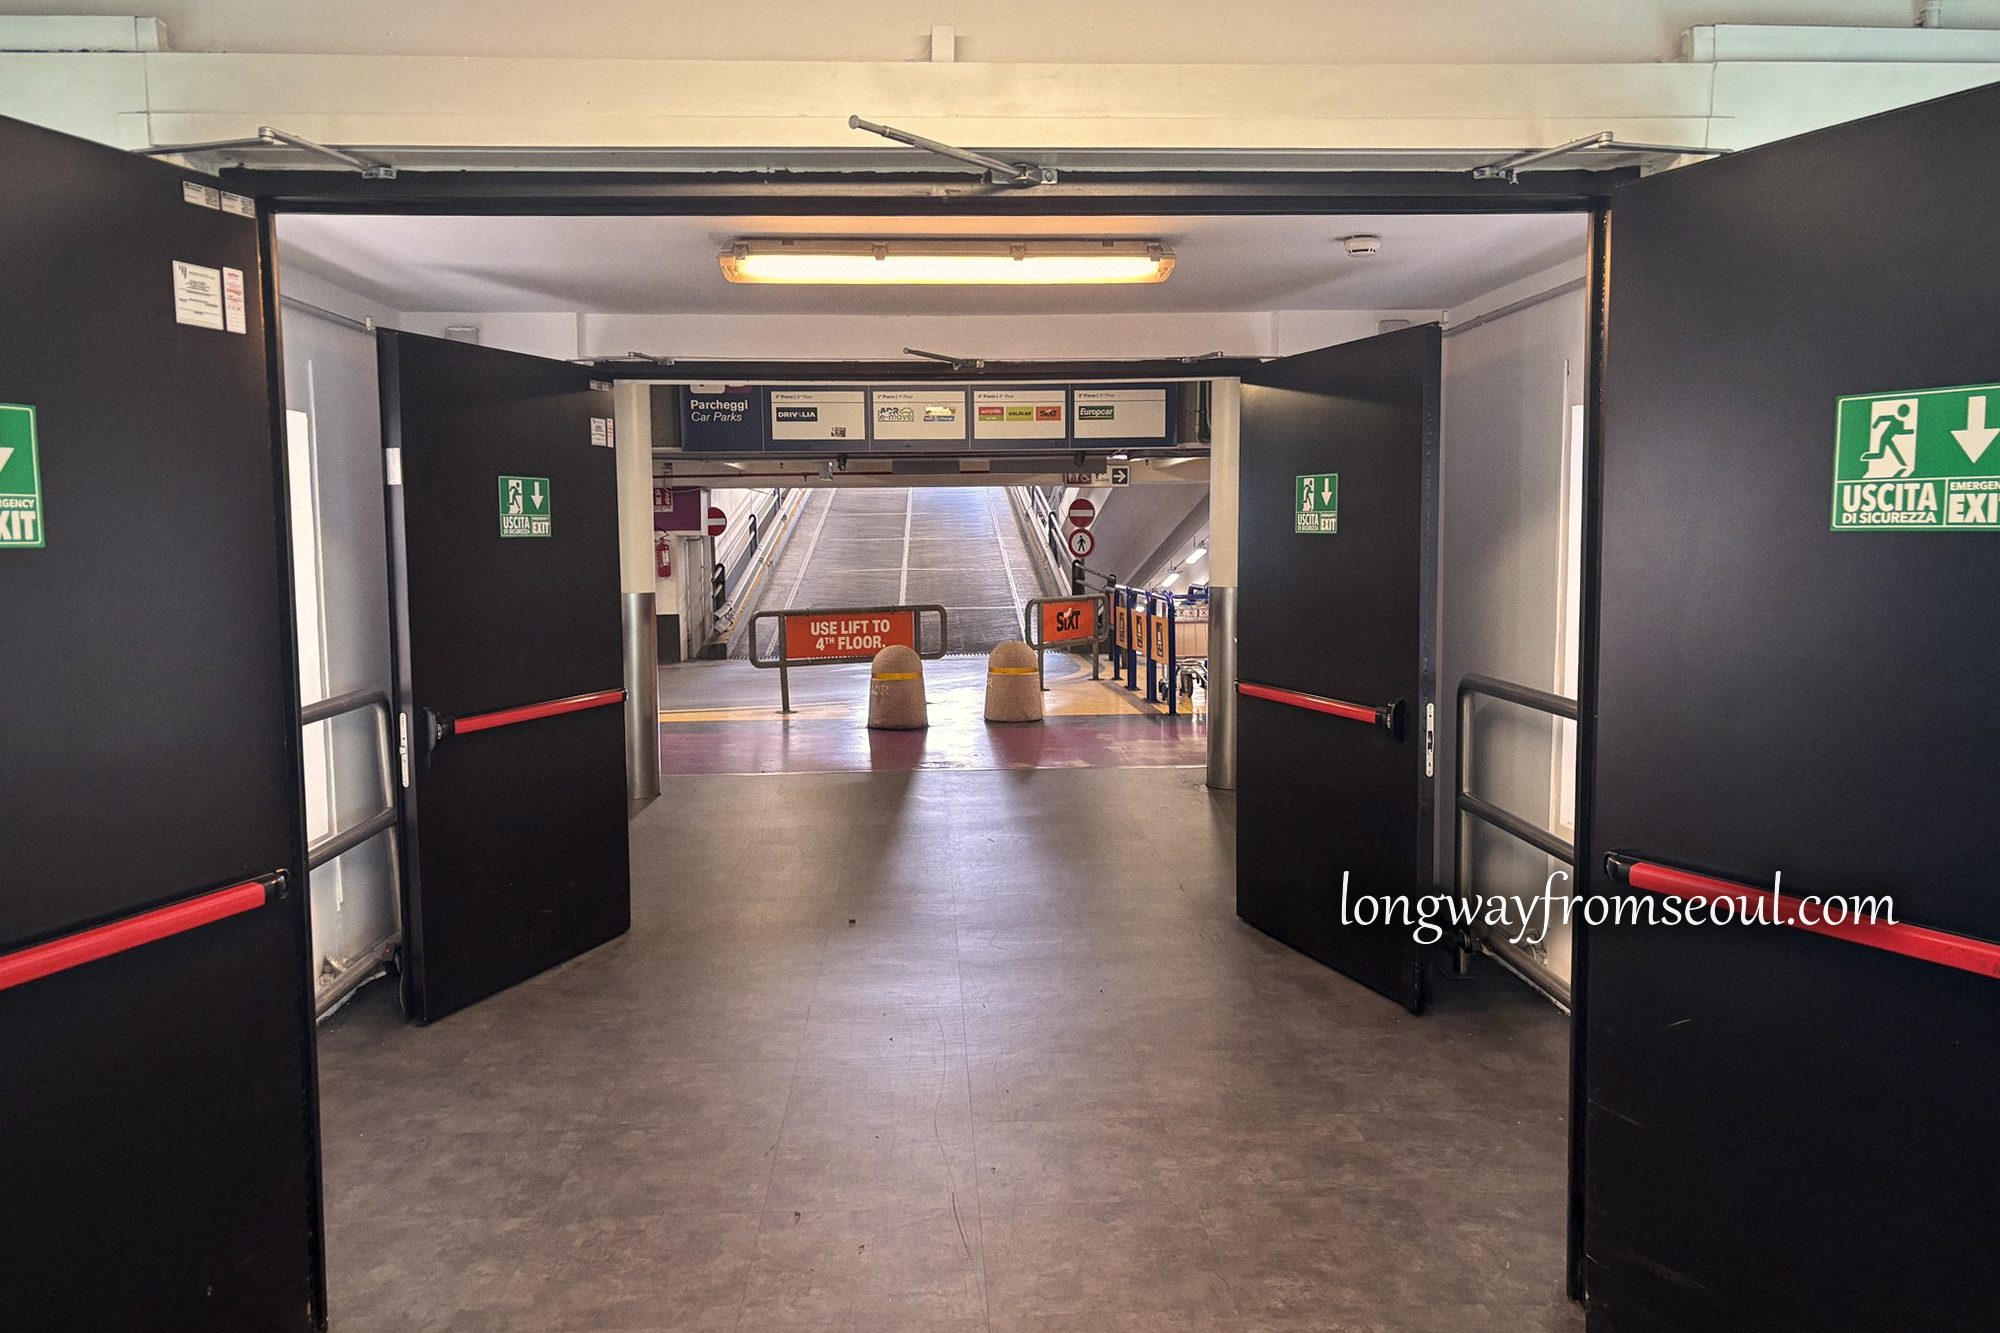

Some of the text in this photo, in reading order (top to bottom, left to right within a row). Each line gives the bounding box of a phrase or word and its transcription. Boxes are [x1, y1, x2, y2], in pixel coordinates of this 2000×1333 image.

[690, 399, 748, 411] Parcheggi
[691, 411, 743, 422] Car Parks
[1080, 408, 1113, 417] Europcar
[0, 498, 35, 509] GENCY
[1843, 483, 1938, 513] USCITA
[1948, 493, 2000, 523] EXI
[503, 516, 530, 529] USCITA
[1297, 513, 1319, 526] USCITA
[1842, 511, 1937, 524] DI SICUREZZA
[532, 522, 550, 534] EXIT
[1320, 518, 1336, 531] EXIT
[810, 619, 890, 635] USE LIFT TO
[815, 635, 886, 651] 4TH FLOOR.
